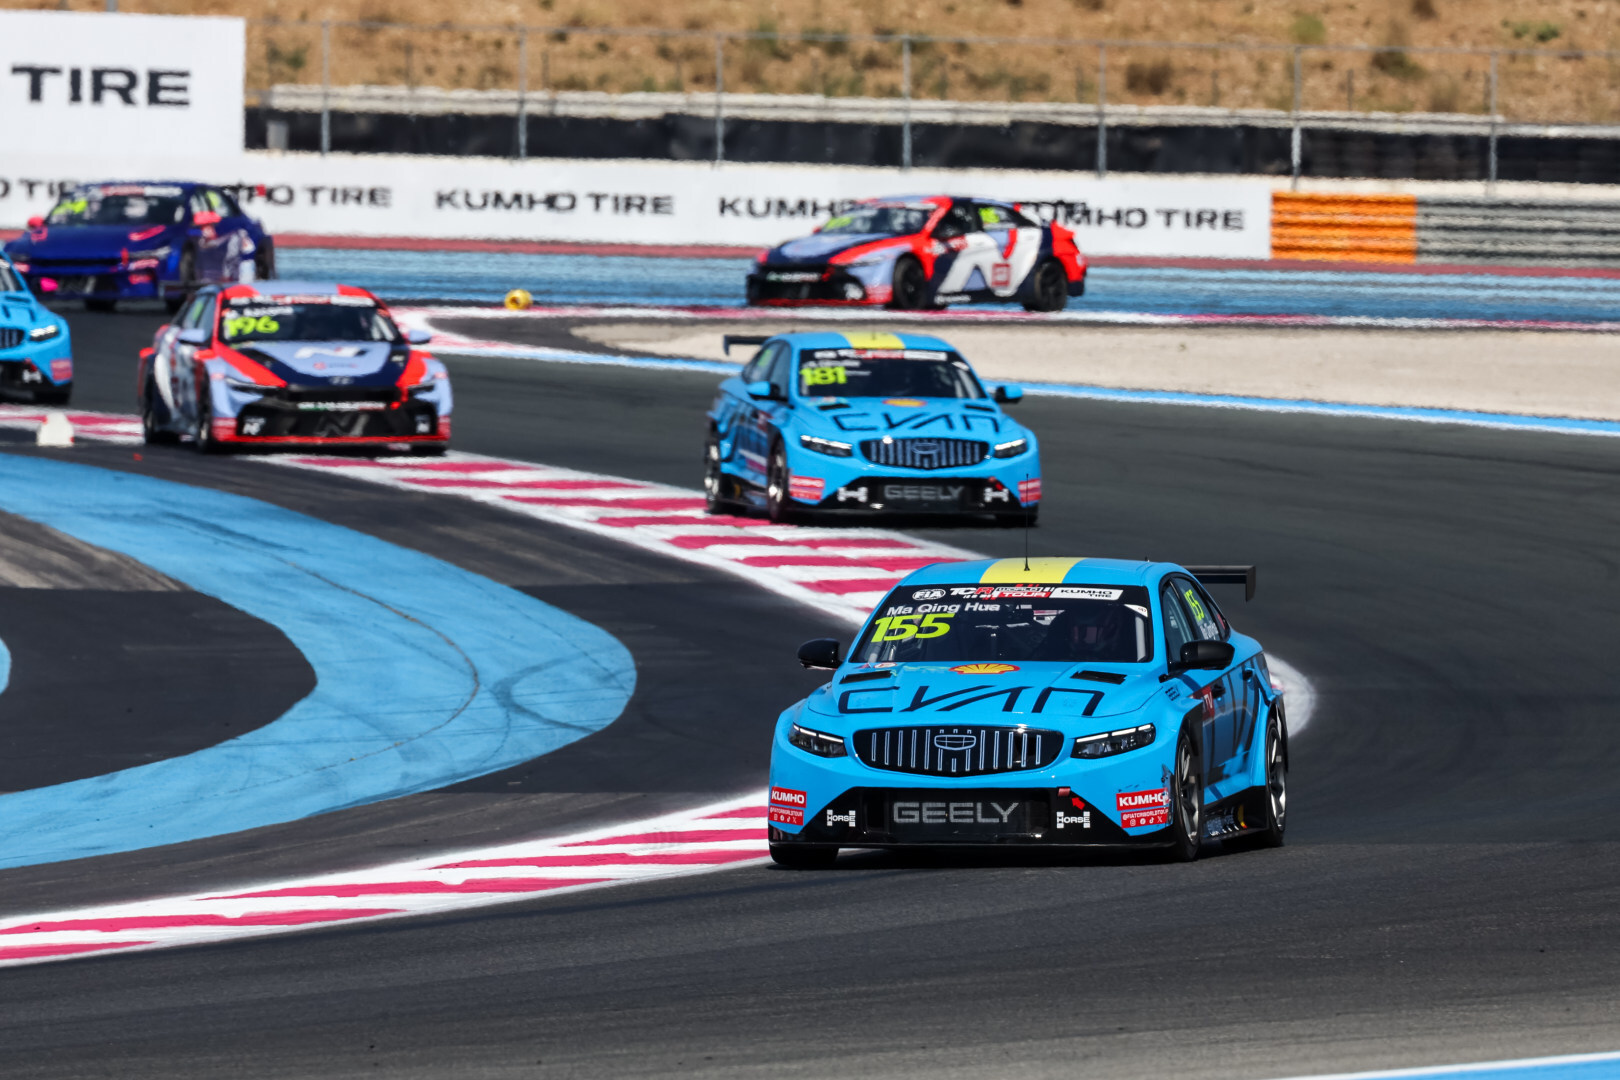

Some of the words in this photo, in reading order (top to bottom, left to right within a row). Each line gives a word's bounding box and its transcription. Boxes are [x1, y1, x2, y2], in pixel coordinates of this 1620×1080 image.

[11, 65, 191, 106] TIRE
[304, 186, 392, 208] TIRE
[434, 189, 576, 212] KUMHO
[585, 192, 674, 215] TIRE
[1155, 209, 1245, 231] TIRE
[799, 365, 848, 386] 181
[883, 484, 965, 501] GEELY
[914, 590, 944, 600] FIA
[950, 586, 995, 596] TCR
[887, 605, 913, 616] Ma
[917, 603, 961, 614] Qing
[964, 602, 1001, 612] Hua
[870, 612, 956, 643] 155
[771, 790, 805, 804] KUMHO
[892, 801, 1020, 824] GEELY
